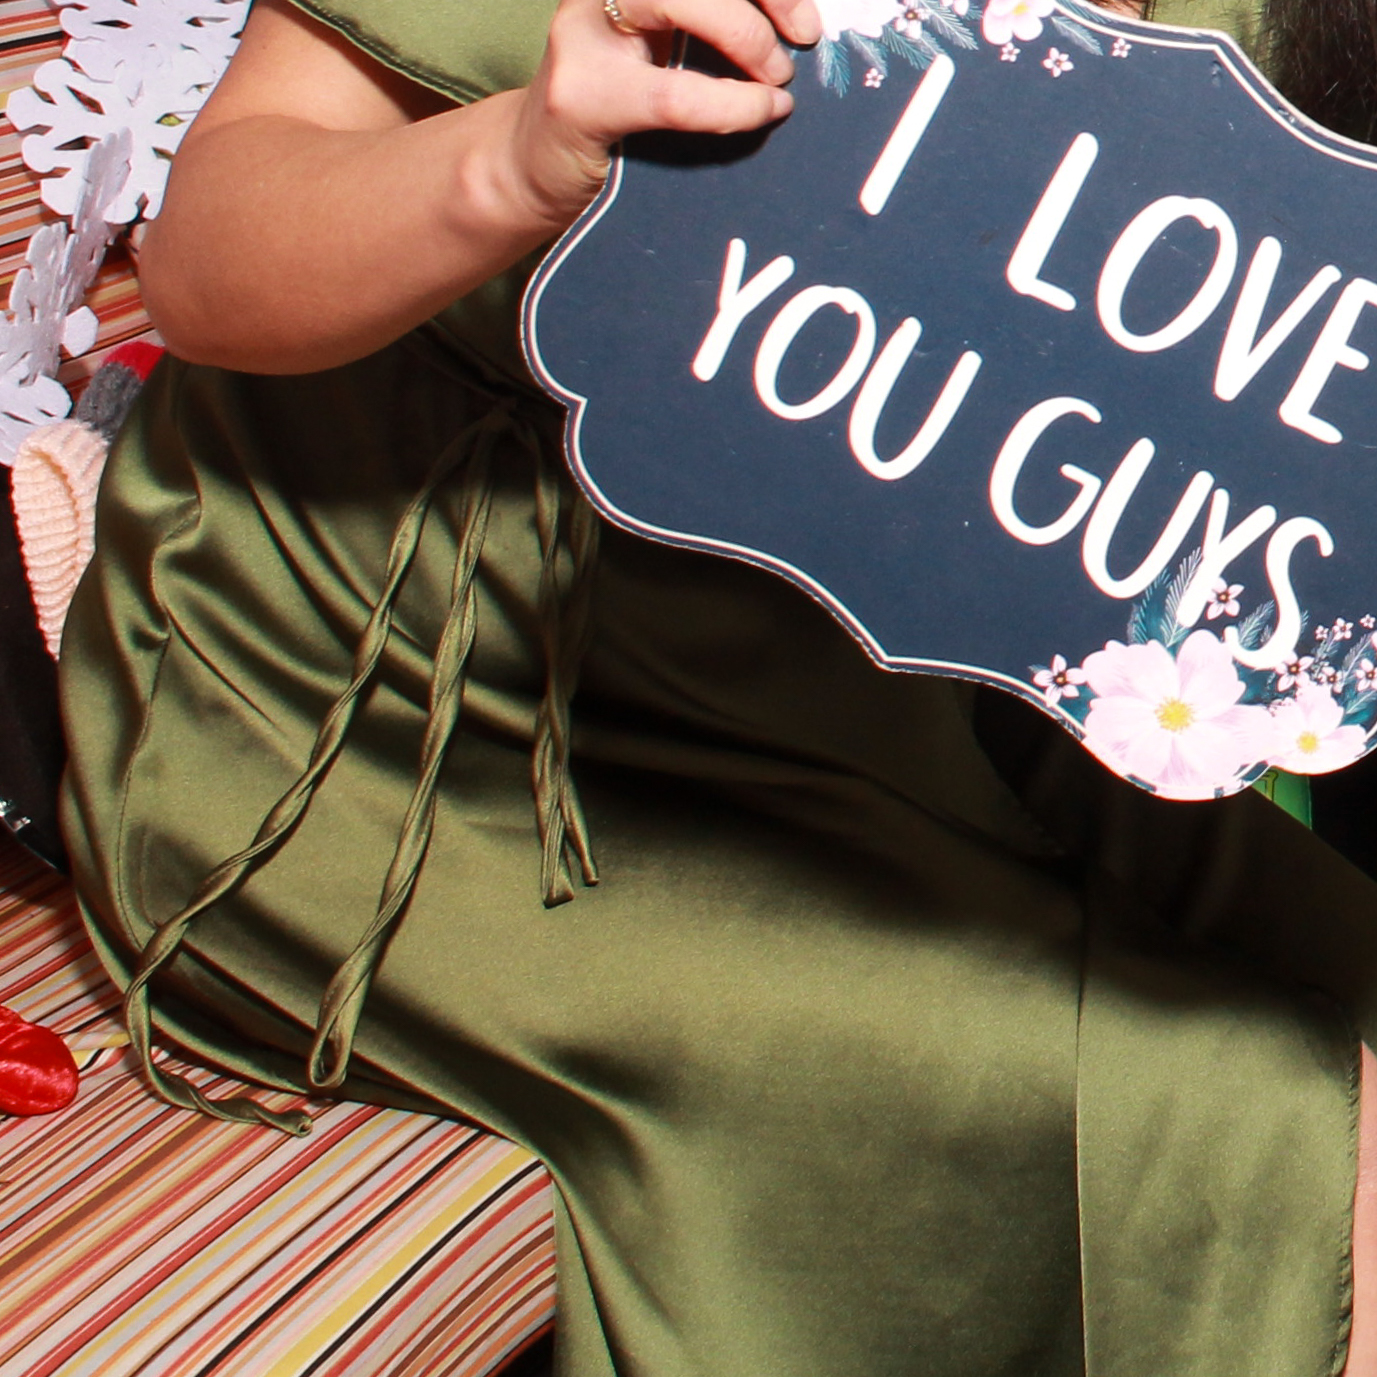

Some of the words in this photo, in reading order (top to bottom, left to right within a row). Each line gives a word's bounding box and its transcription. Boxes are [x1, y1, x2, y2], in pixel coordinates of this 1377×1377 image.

[859, 53, 956, 216] I
[691, 237, 983, 482] YOU
[989, 396, 1335, 670] GUYS
